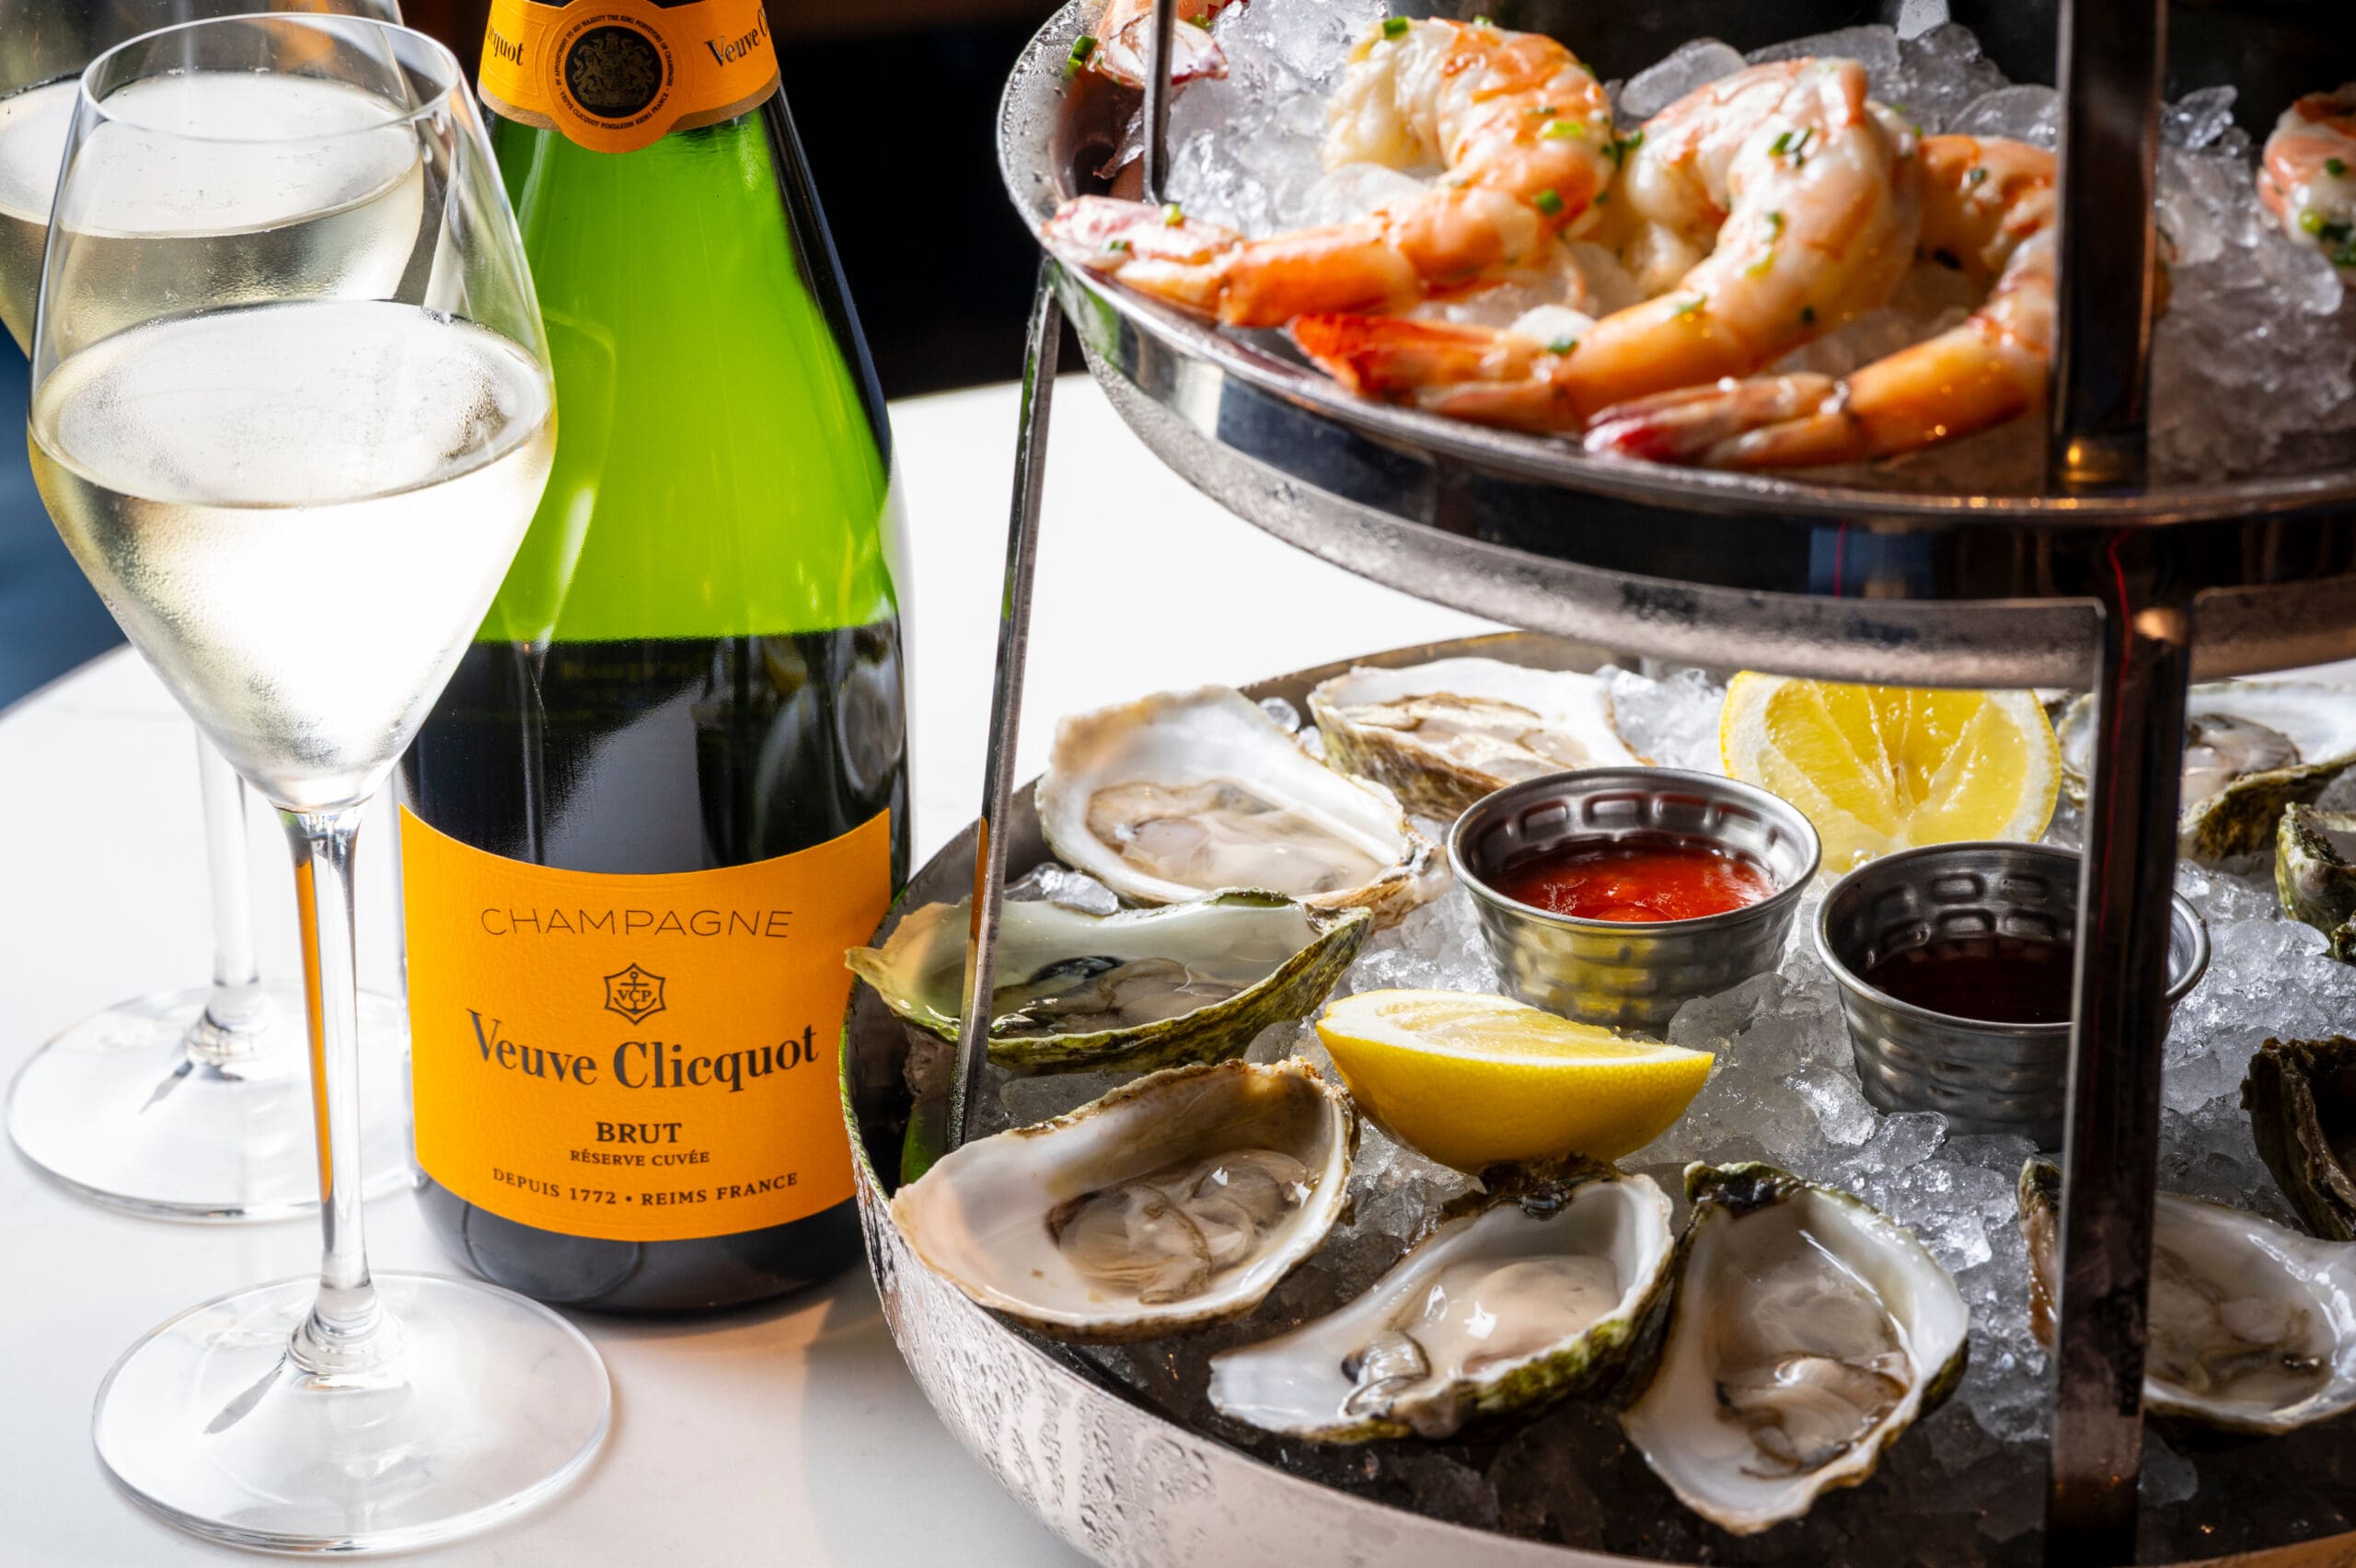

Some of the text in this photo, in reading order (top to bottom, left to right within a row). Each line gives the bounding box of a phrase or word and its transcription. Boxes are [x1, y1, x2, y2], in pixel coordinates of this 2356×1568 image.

[703, 29, 759, 67] Veuve
[572, 110, 599, 127] CLICQUOT
[480, 908, 793, 939] CHAMPAGNE
[617, 989, 653, 1003] VCP
[467, 1008, 819, 1092] Veuve Clicquot
[595, 1121, 683, 1145] BRUT
[570, 1147, 710, 1167] RÉSERVE CUVÉE
[493, 1168, 799, 1206] DEPUIS 1772 REIMS FRANCE
